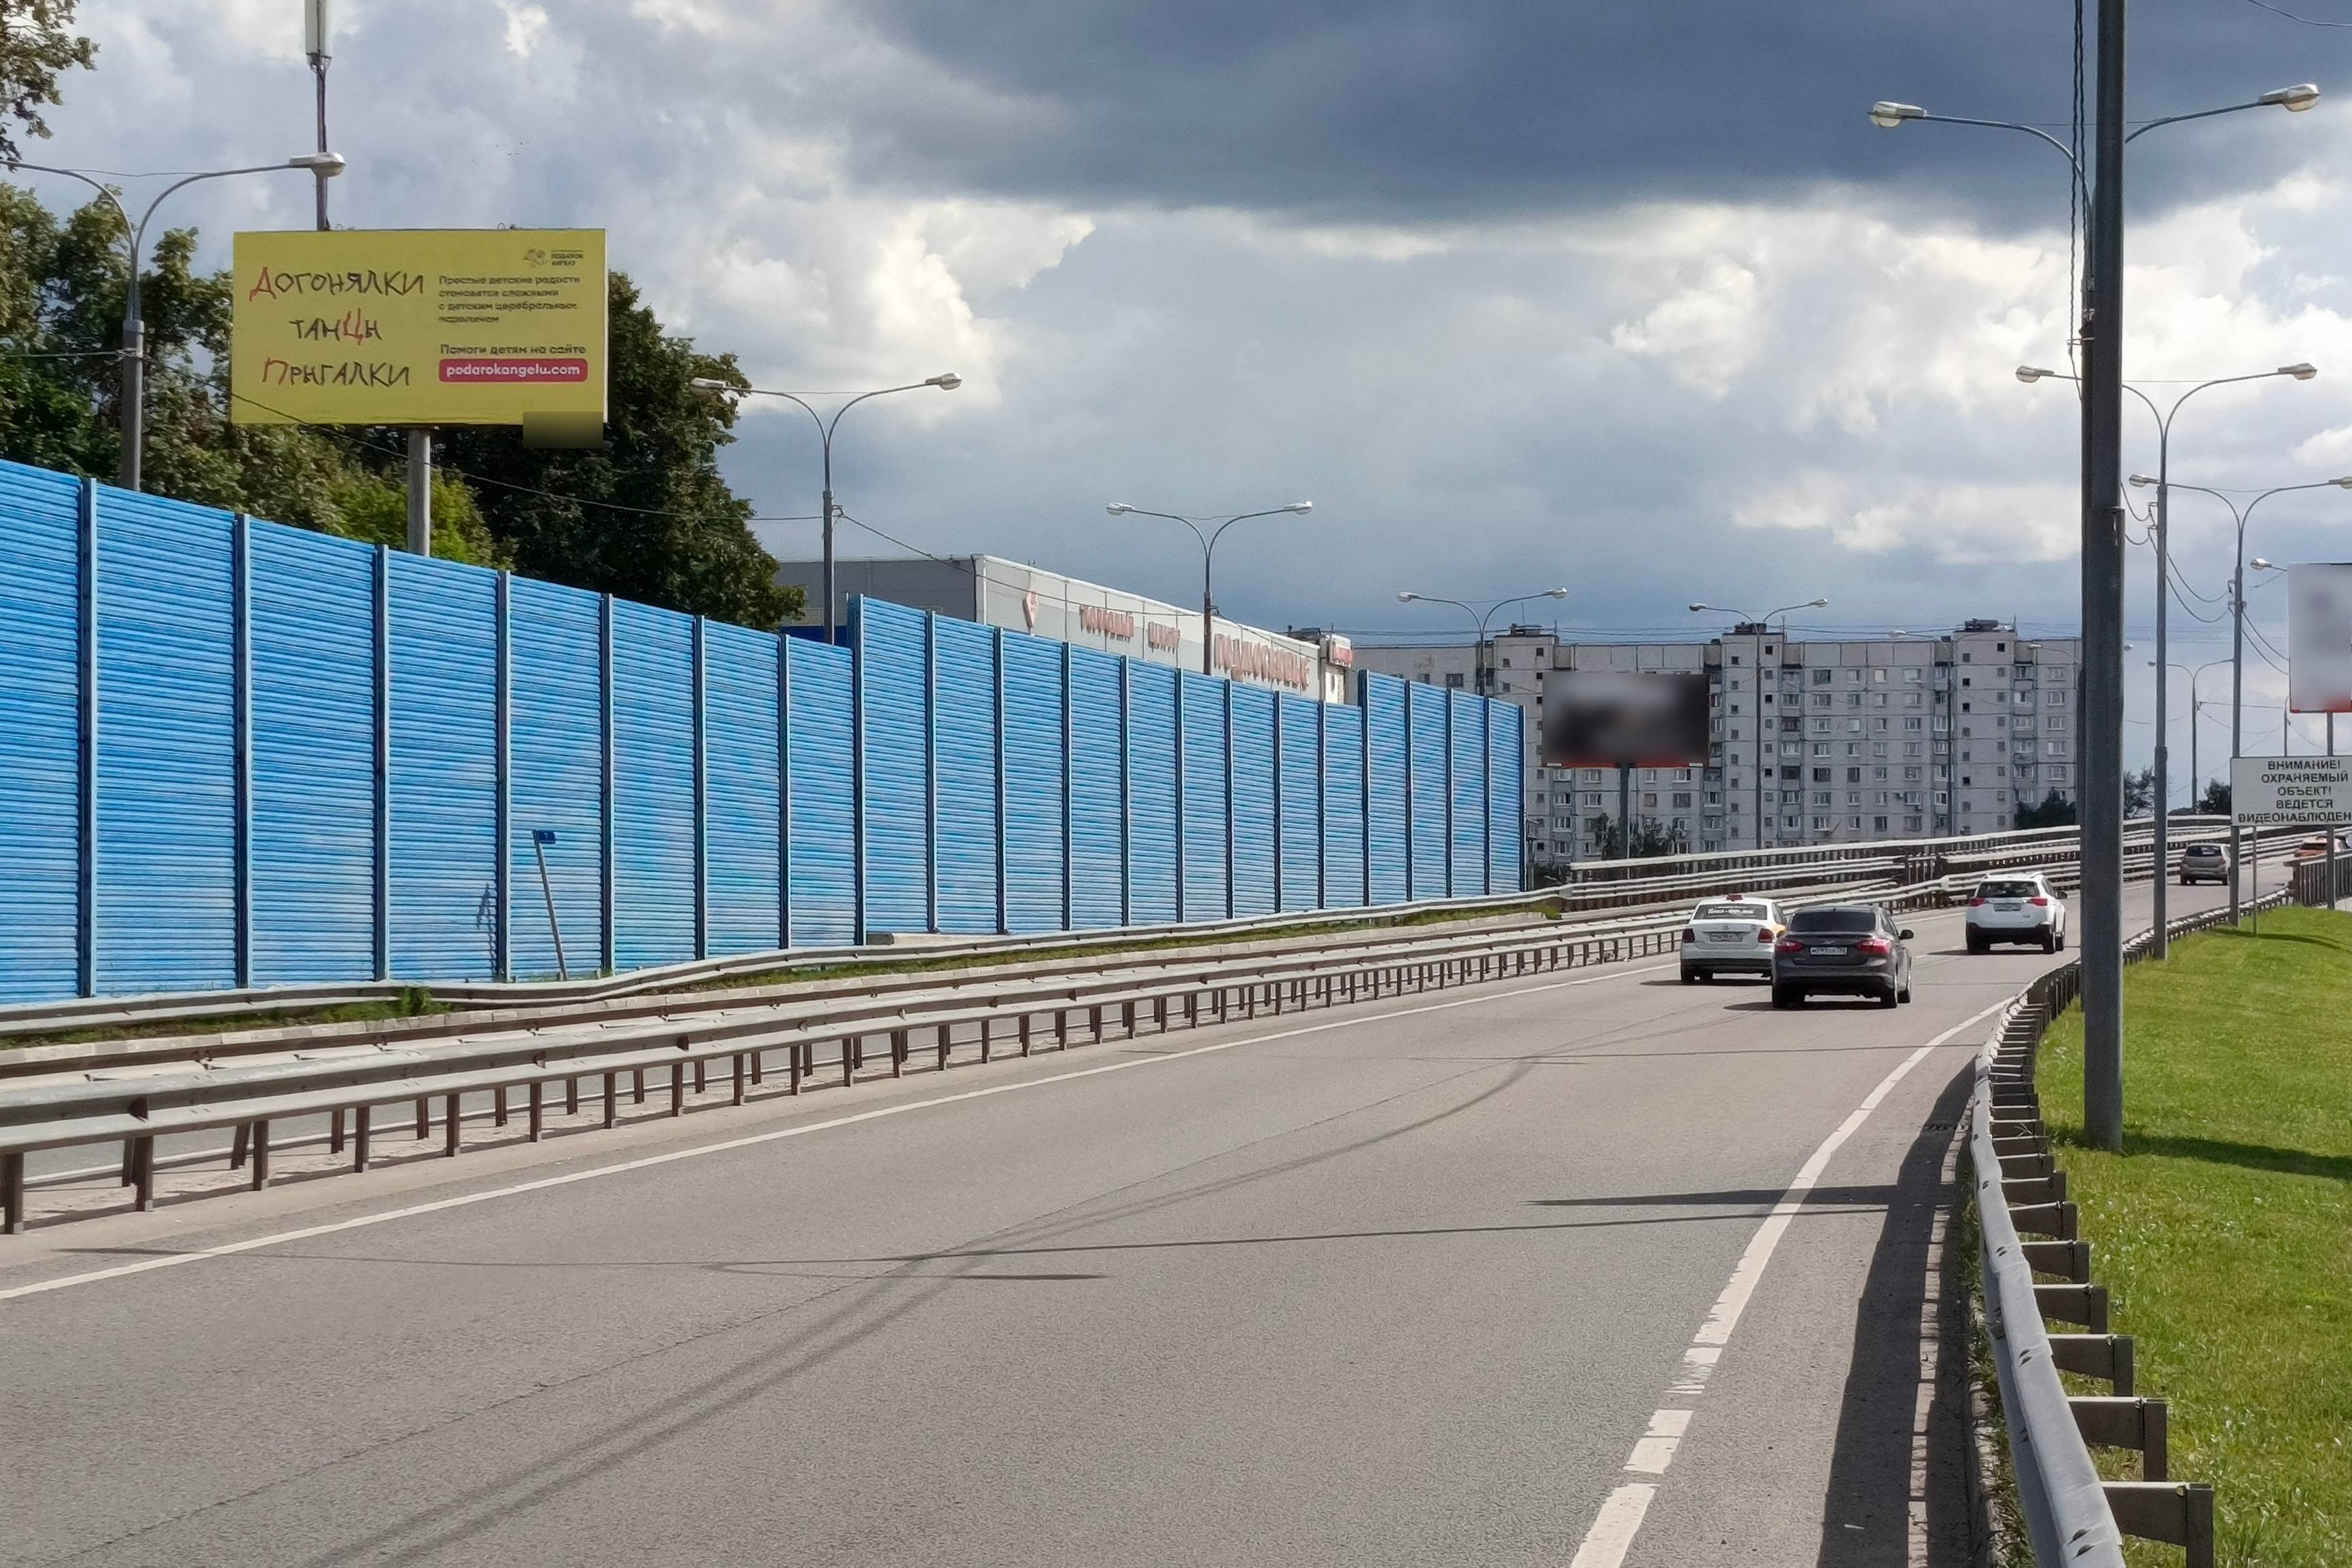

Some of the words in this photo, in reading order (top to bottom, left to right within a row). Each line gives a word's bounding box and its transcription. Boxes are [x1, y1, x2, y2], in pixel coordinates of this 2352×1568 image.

[249, 266, 423, 302] ДОГОНЯЛКИ
[535, 276, 580, 286] радости
[441, 344, 486, 354] Помоги
[490, 345, 527, 355] детям
[549, 343, 587, 354] сайте
[261, 357, 410, 386] ПРЫГАЛКИ
[446, 363, 580, 378] podarokangelu.com
[2268, 760, 2340, 770] ВНИМАНИЕ!
[2261, 771, 2349, 783] ОХРАНЯЕМЫЙ
[2277, 786, 2332, 796] ОБЪЕКТ!
[2276, 799, 2334, 809] ВЕДЕТСЯ
